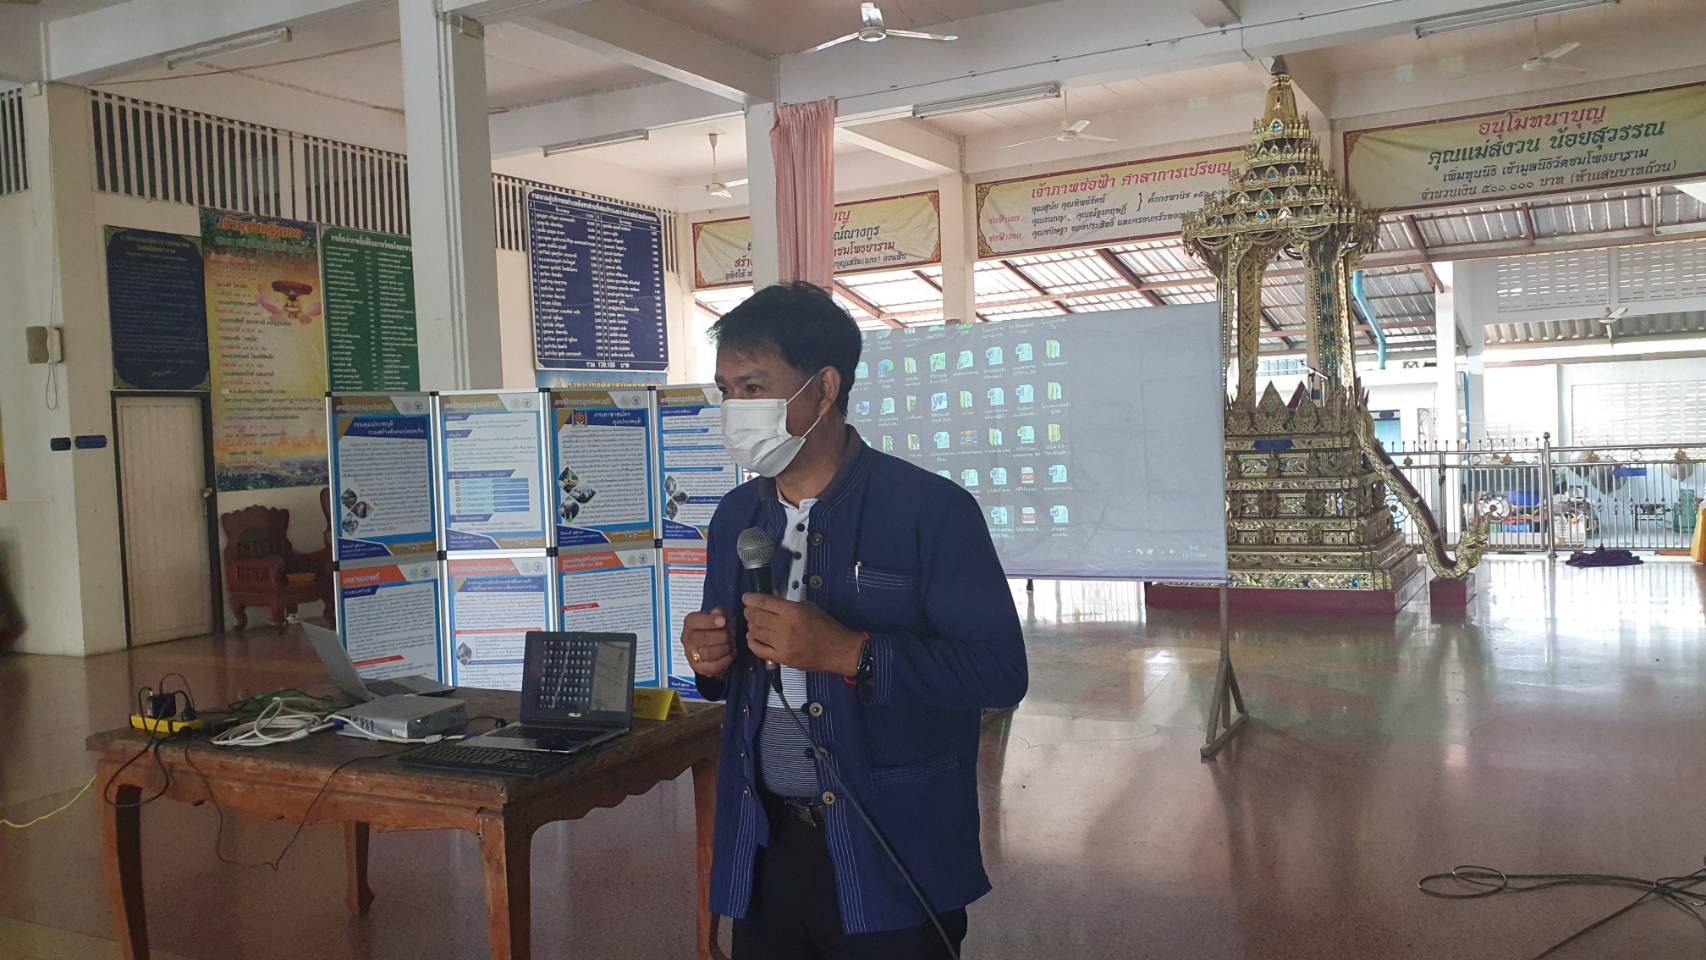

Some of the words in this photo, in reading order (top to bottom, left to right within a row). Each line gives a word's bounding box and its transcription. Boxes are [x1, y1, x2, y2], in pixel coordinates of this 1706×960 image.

[1478, 105, 1608, 140] อนุโมทนาบุญ
[1427, 136, 1540, 172] คุณแม่สงวน
[1550, 120, 1666, 151] น้อยสุวรรณ
[1031, 172, 1116, 199] เจ้าภาพช่อฟ้า
[1121, 160, 1232, 186] ศาลาการเปรียญ
[1420, 182, 1477, 201] จำนวนเงิน
[1539, 173, 1565, 187] บาท
[1570, 160, 1677, 184] (ห้าแสนบาทถ้วน)
